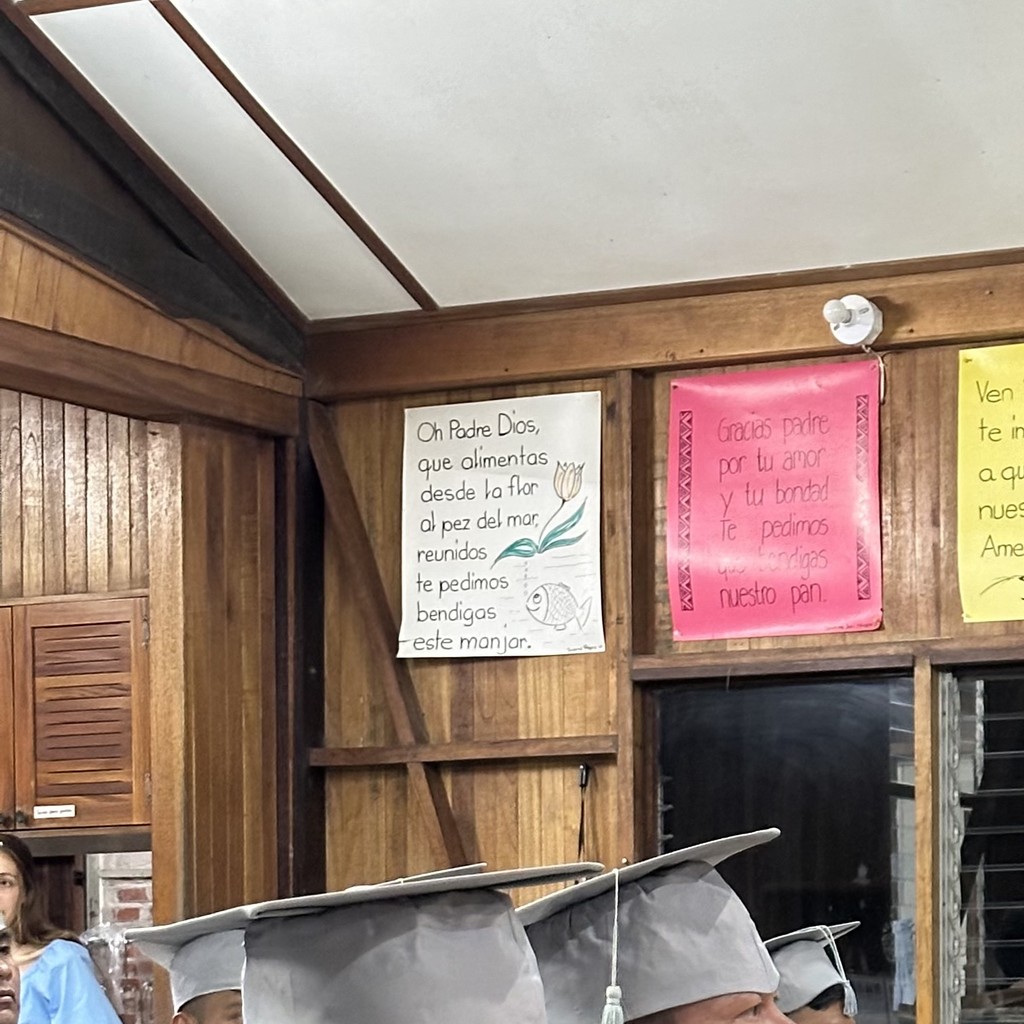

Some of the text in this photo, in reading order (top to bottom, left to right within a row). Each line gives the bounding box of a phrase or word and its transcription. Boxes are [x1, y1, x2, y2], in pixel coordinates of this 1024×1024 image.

[976, 380, 1013, 403] Ven
[417, 410, 540, 442] Oh Padre Dios,
[718, 411, 830, 444] Gracias padre
[979, 417, 1002, 442] te
[418, 445, 548, 480] que alimentas
[719, 447, 824, 482] por tu amor
[979, 467, 996, 482] a
[421, 475, 538, 502] desde la flor
[721, 476, 829, 517] y tu bondad
[420, 508, 539, 538] al pez del mar,
[720, 514, 829, 542] Te pedimos
[417, 539, 487, 562] reunidos
[416, 573, 509, 598] te pedimos
[720, 581, 827, 613] nuestro pan.
[417, 602, 496, 626] bendigas
[413, 624, 531, 654] este manjar.
